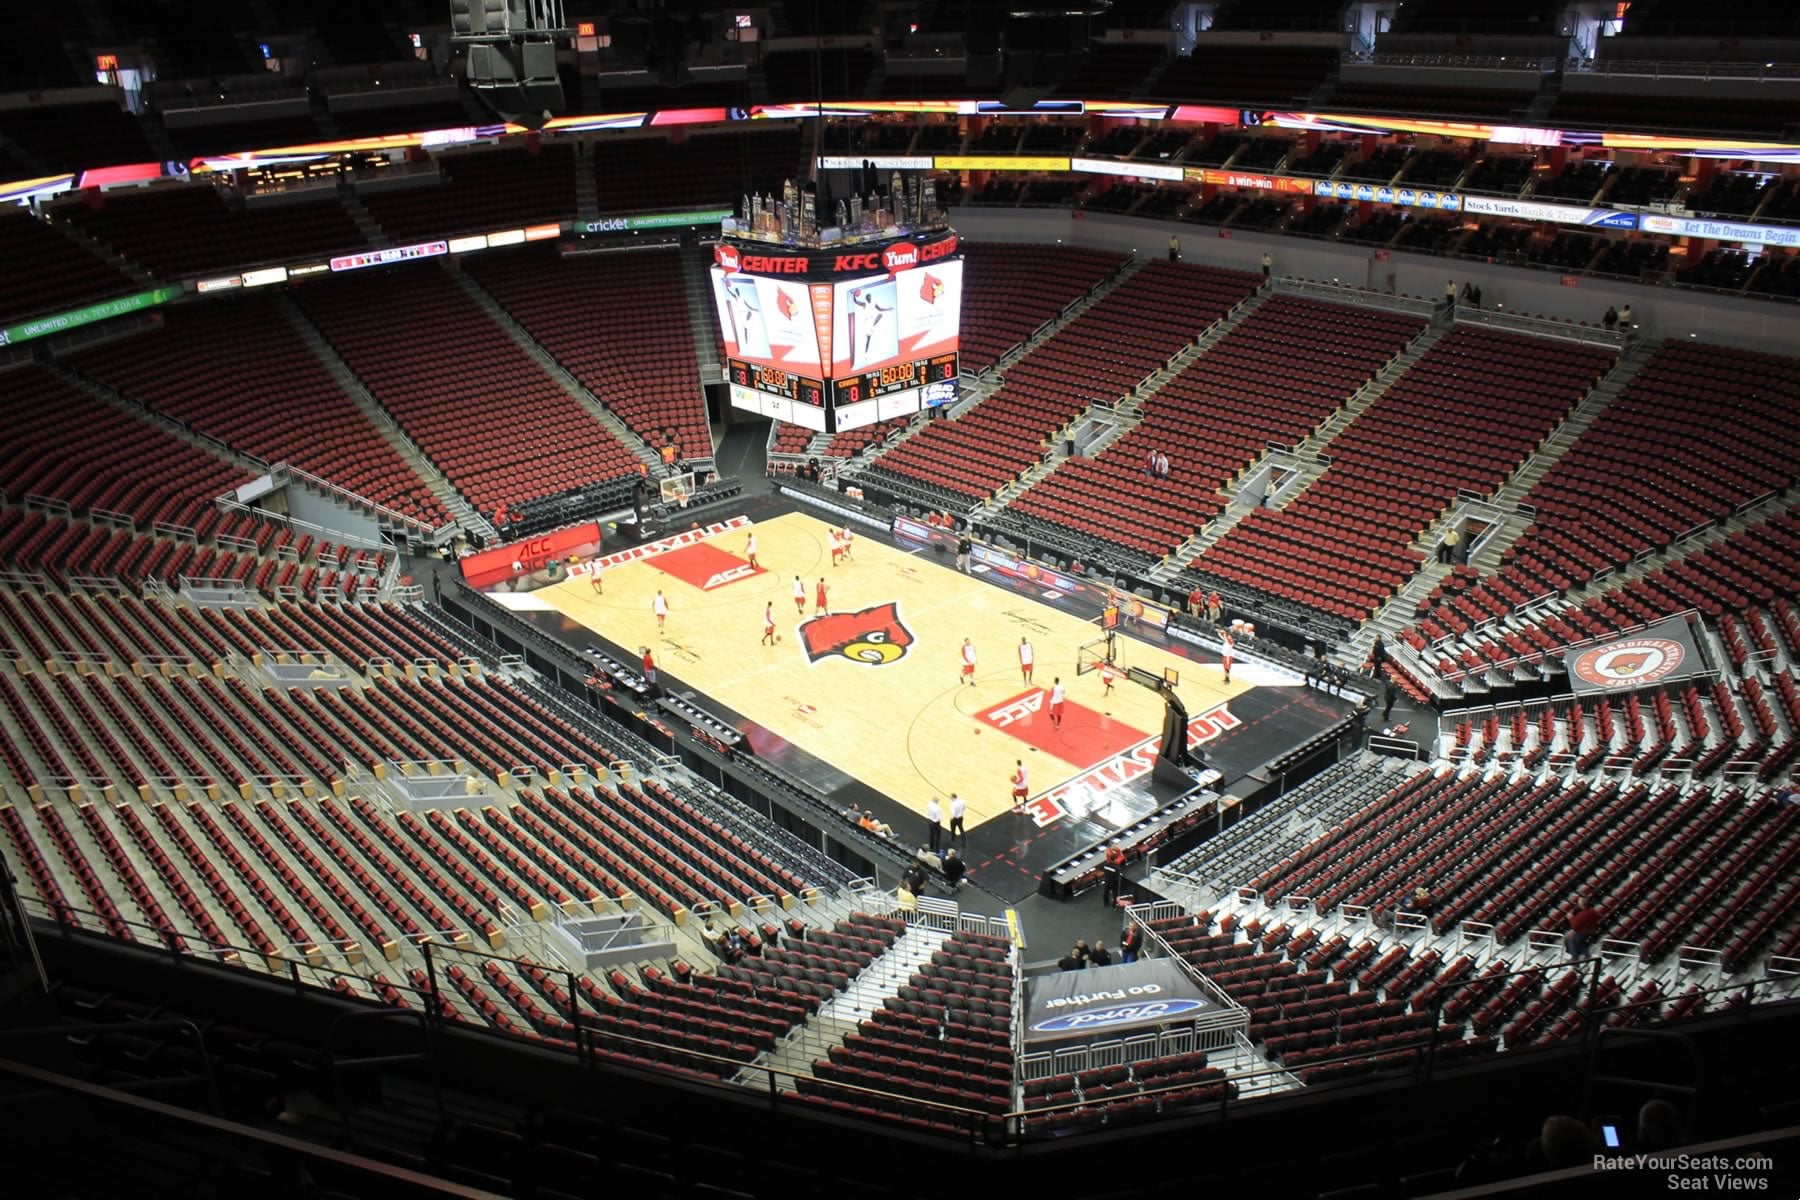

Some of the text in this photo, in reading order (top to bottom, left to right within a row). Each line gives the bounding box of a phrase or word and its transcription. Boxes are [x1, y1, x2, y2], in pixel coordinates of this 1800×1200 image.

[1228, 176, 1235, 185] a
[1236, 175, 1273, 189] win-win
[634, 217, 668, 226] UNLIMITED
[1466, 200, 1583, 221] Stock Yards Bank & Trust
[586, 218, 629, 233] cricket
[1684, 221, 1797, 244] Let The Dreams Begin
[742, 256, 809, 274] CENTER
[833, 254, 880, 272] KFC
[882, 248, 918, 268] Yum!
[24, 318, 68, 336] UNLIMITED
[120, 298, 141, 311] DATA
[763, 367, 787, 387] 60:00
[882, 364, 913, 384] 60:00
[519, 538, 552, 561] ACC
[563, 515, 755, 583] LOUISVILLE
[703, 564, 756, 590] ACC
[1598, 640, 1665, 653] CARDINAL
[987, 690, 1046, 728] ACC
[1045, 984, 1162, 1009] Go Further
[1067, 1003, 1169, 1027] Ford
